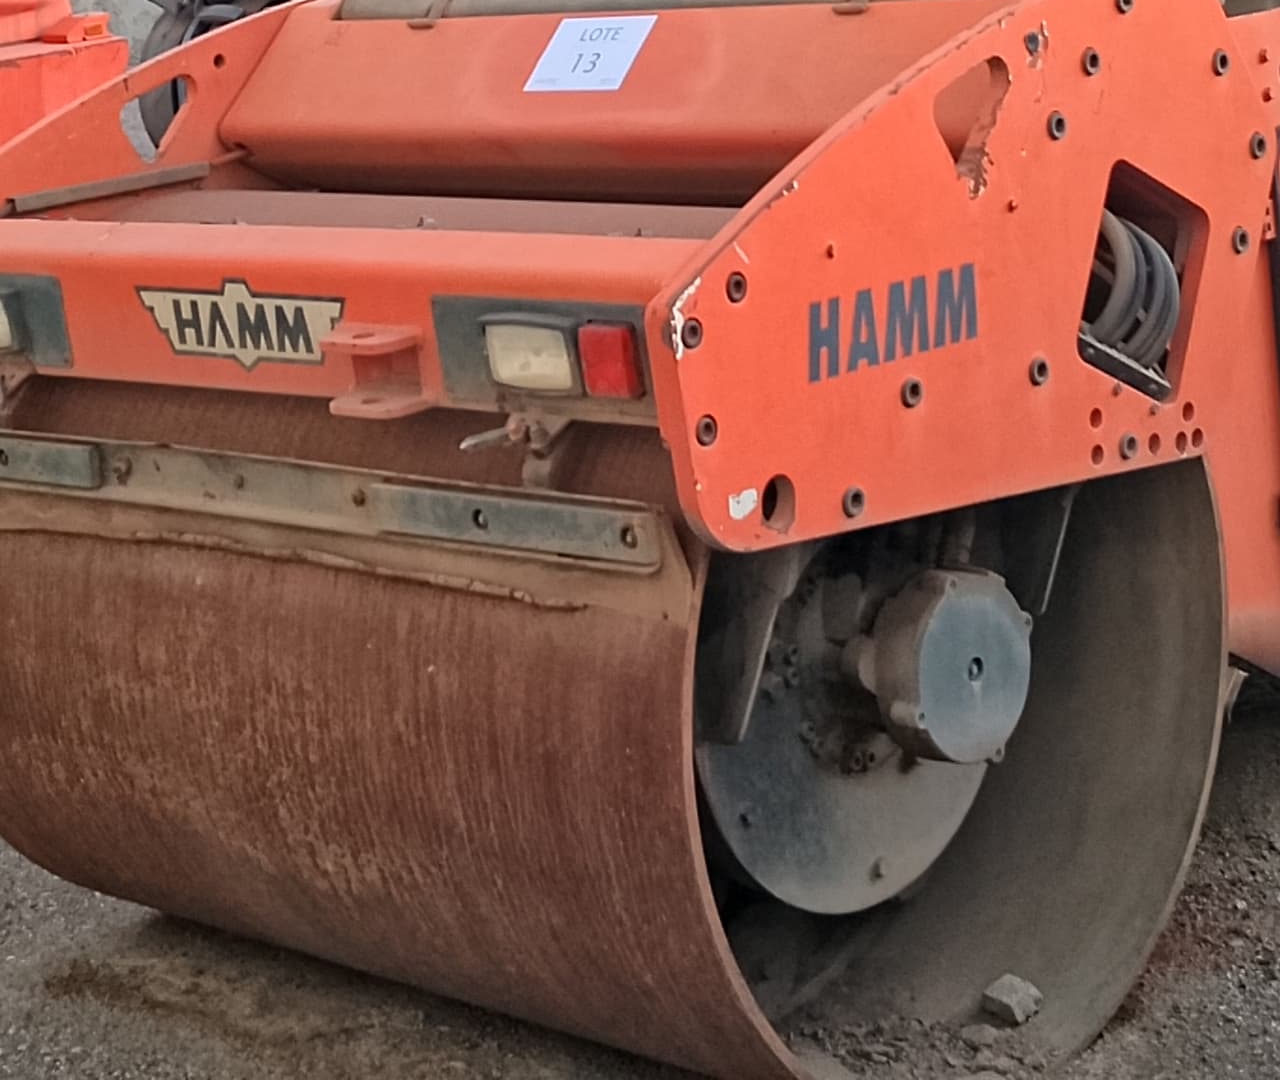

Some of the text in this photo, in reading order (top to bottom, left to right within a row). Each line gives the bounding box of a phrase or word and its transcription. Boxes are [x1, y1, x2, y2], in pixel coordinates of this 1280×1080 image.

[579, 26, 624, 42] LOTE
[570, 52, 601, 73] 13
[172, 298, 314, 354] HAMM
[809, 263, 978, 383] HAMM
